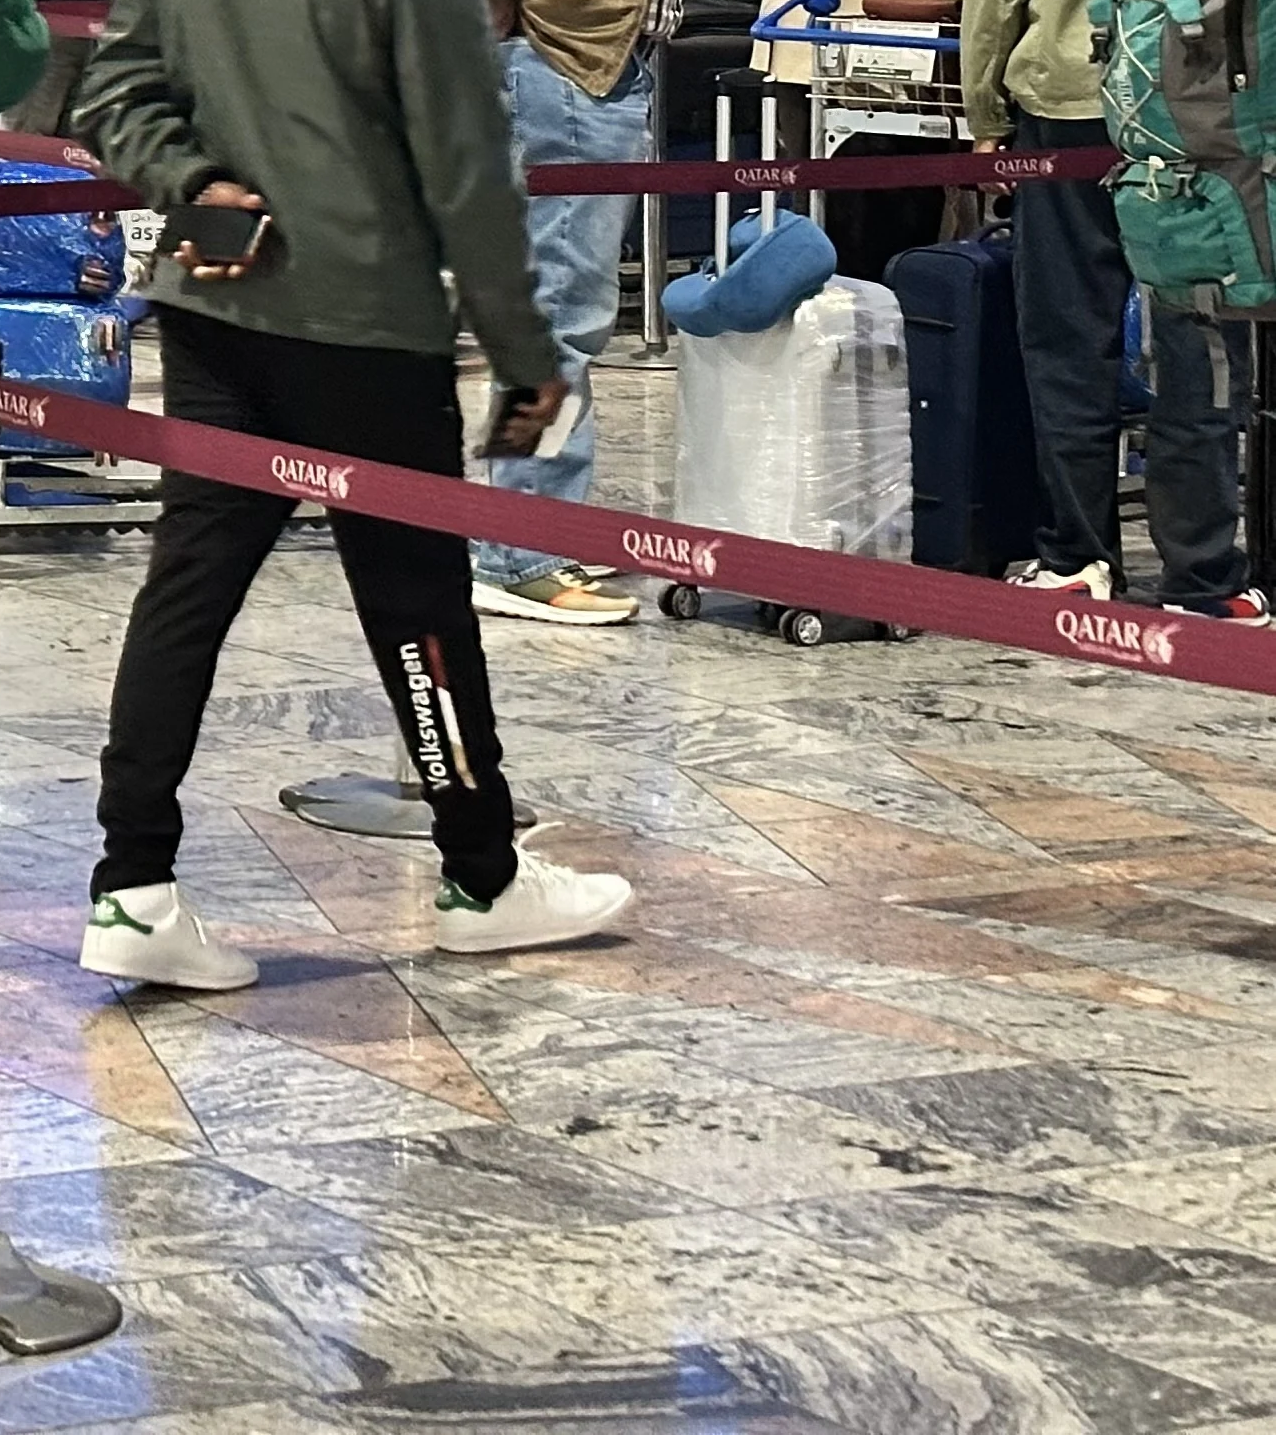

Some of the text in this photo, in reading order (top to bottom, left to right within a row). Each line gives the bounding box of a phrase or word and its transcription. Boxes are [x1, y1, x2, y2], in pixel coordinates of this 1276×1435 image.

[735, 167, 781, 185] QATAR
[994, 158, 1040, 177] QATAR
[271, 454, 329, 488] QATAR
[621, 528, 691, 565] QATAR
[1054, 608, 1141, 649] QATAR
[399, 642, 451, 791] Volkswagen
